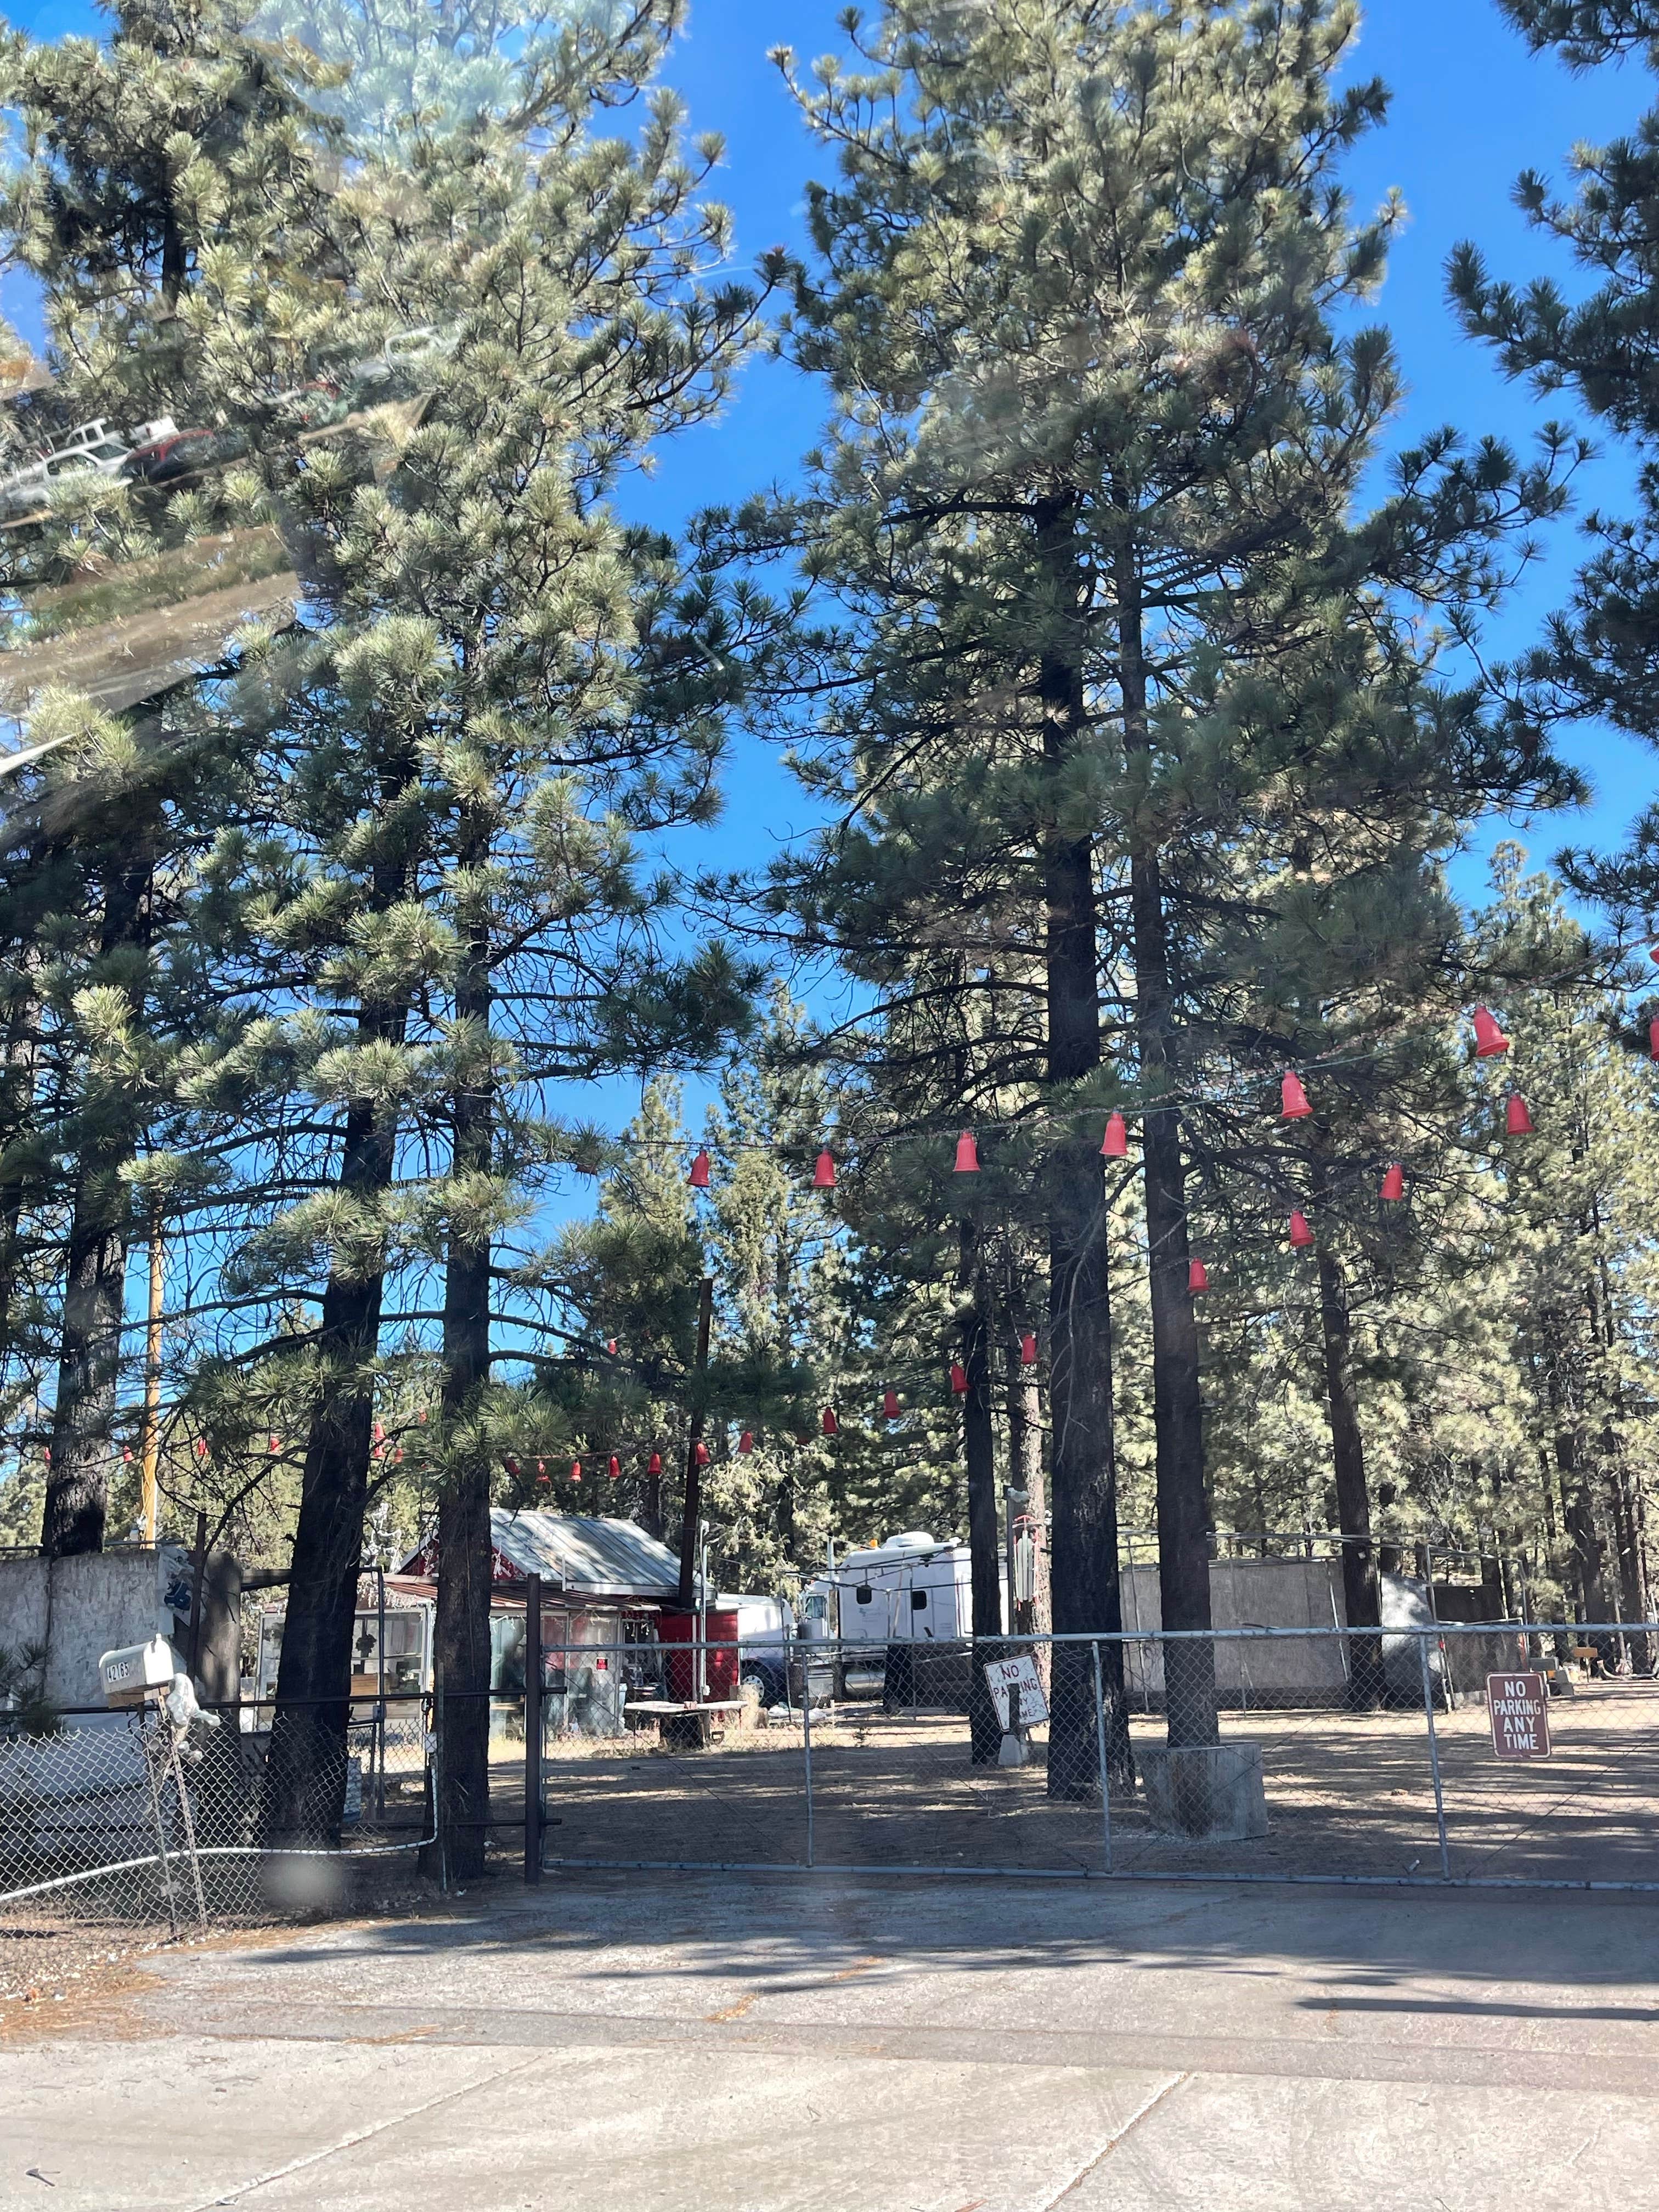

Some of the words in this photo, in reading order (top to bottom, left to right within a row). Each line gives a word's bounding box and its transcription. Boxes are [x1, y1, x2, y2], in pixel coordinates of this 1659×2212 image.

[108, 1662, 129, 1681] 42165
[1001, 1664, 1019, 1680] NO
[993, 1678, 1037, 1699] PAING
[1504, 1680, 1526, 1697] NO
[1493, 1700, 1541, 1716] PARKING
[1503, 1716, 1535, 1733] ANY
[1504, 1734, 1539, 1750] TIME
